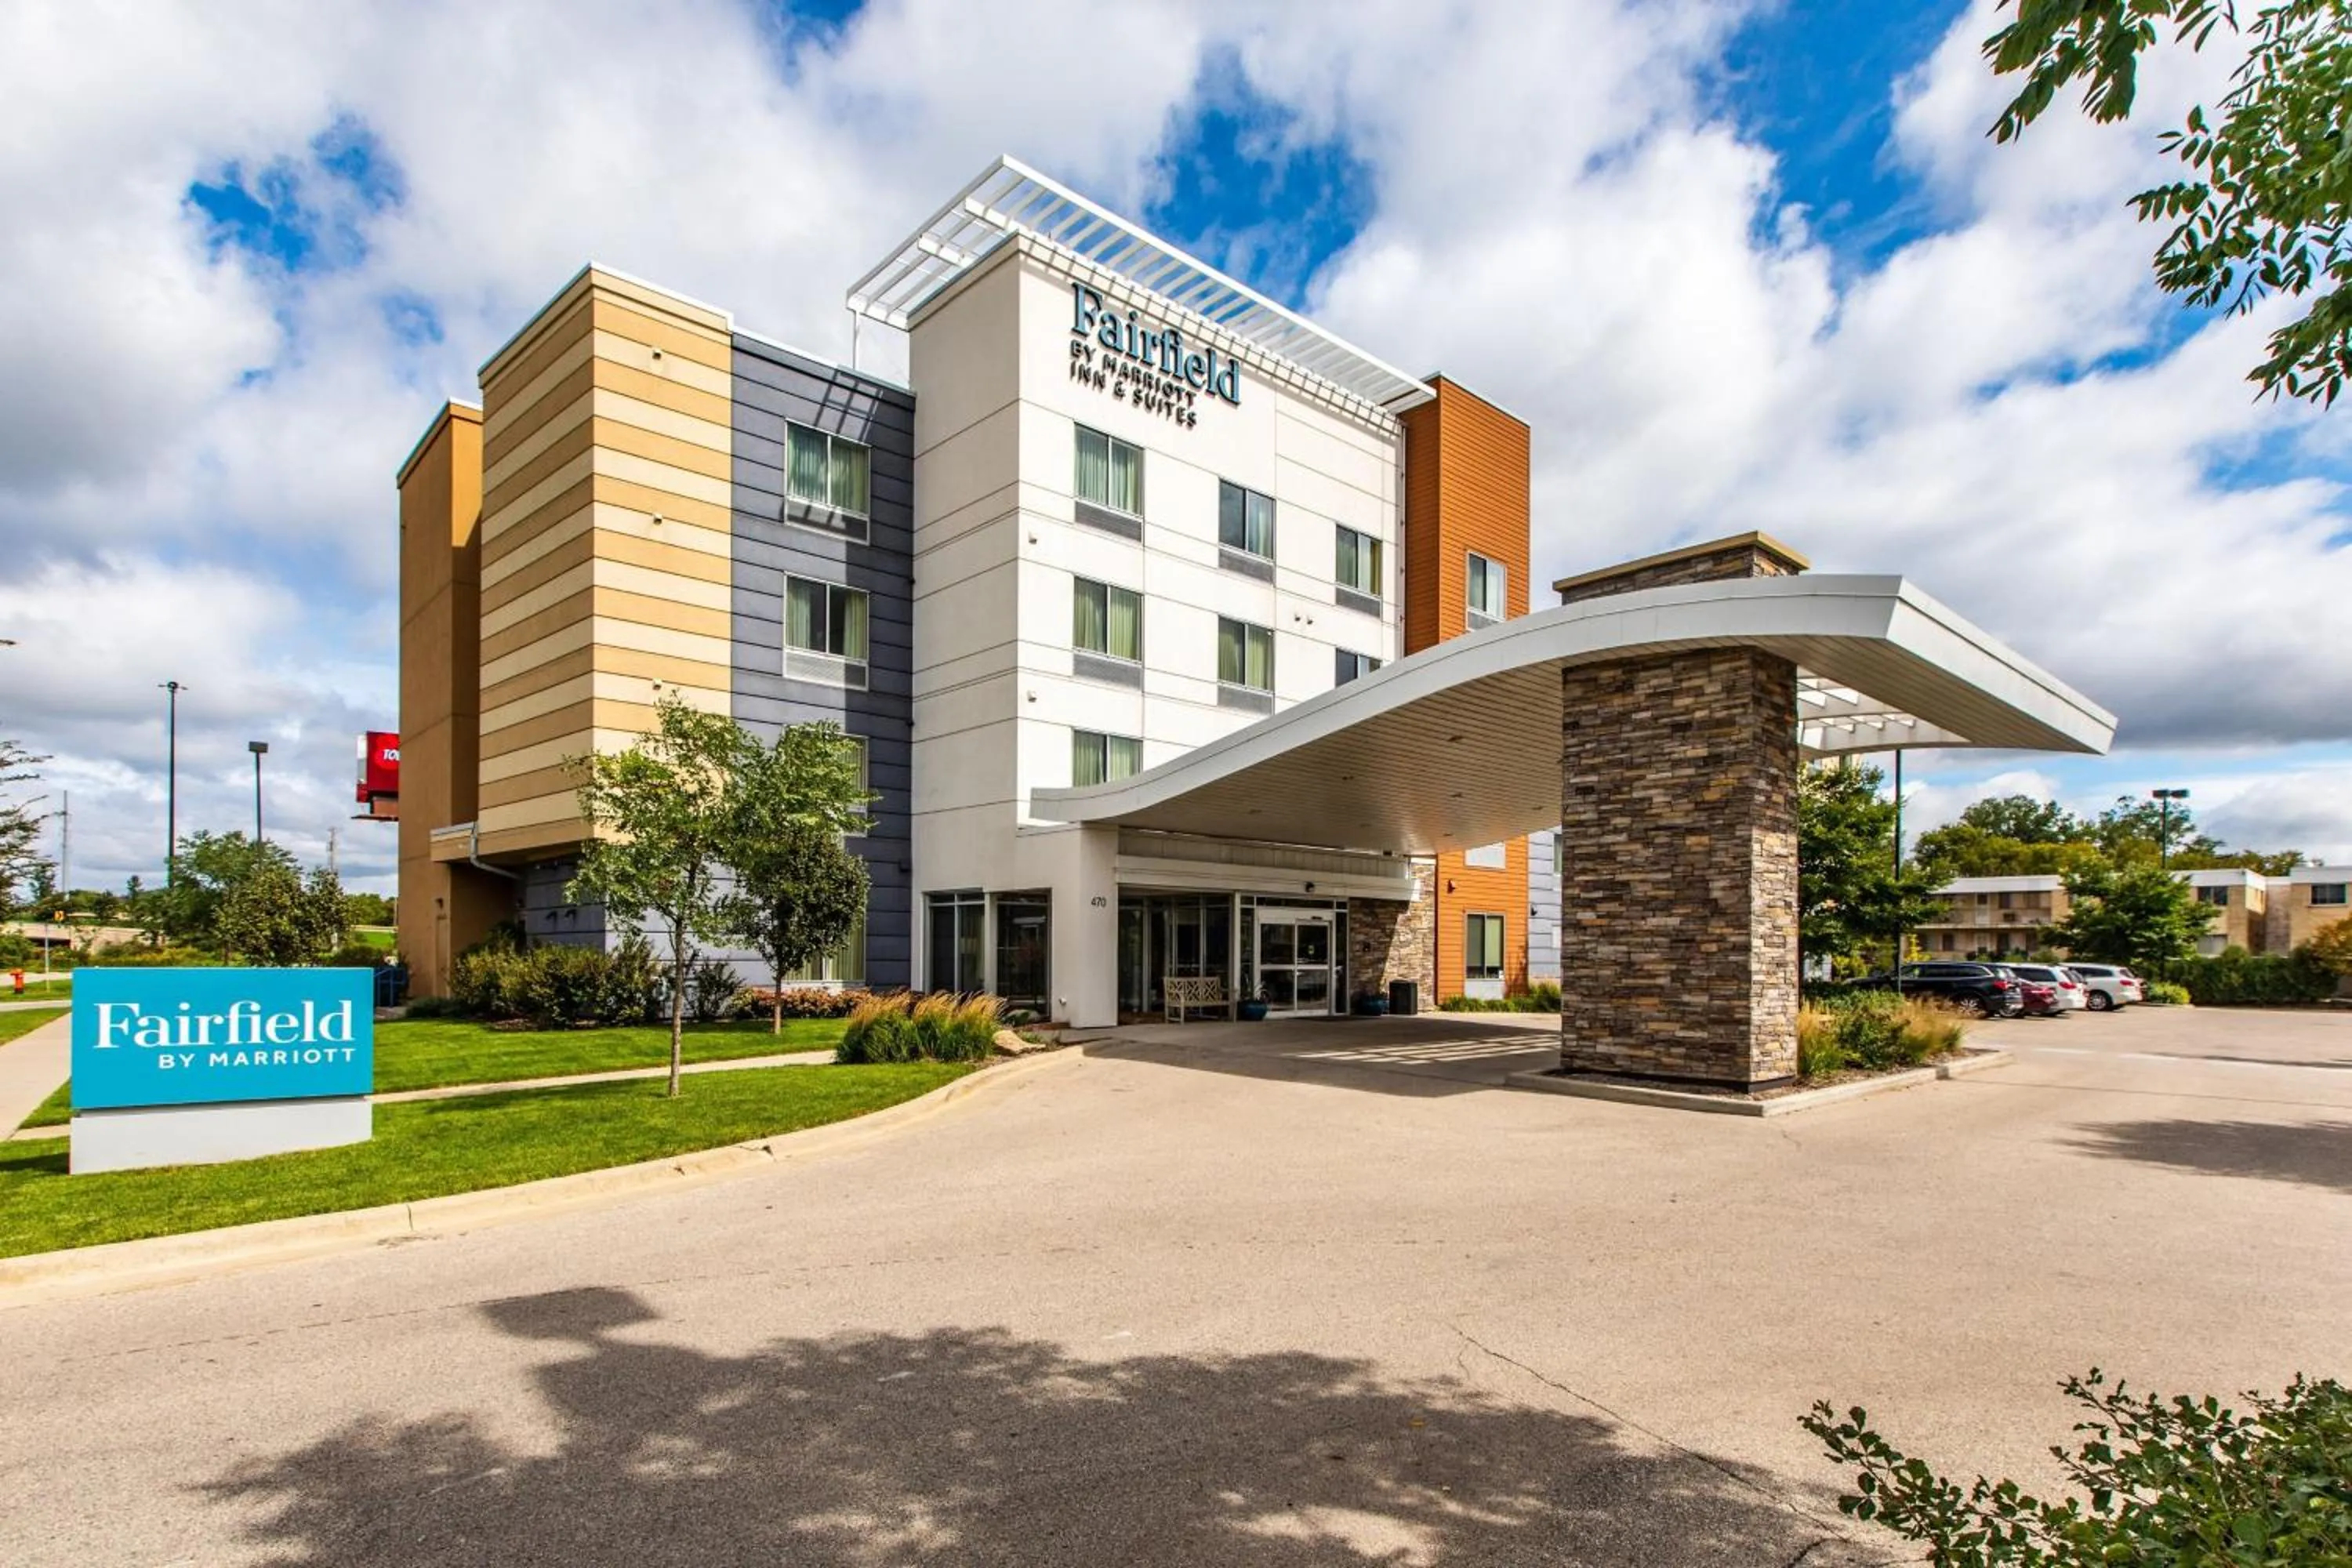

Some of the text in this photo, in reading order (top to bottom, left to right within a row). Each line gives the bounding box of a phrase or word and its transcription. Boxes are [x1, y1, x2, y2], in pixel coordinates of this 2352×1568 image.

[1070, 339, 1197, 407] BY MARRIOTT
[1071, 282, 1241, 407] Fairfield
[1069, 362, 1197, 430] INN & SUITES
[1091, 896, 1107, 908] 470
[93, 1000, 355, 1049] Fairfield
[159, 1048, 357, 1069] BY MARRIOTT
